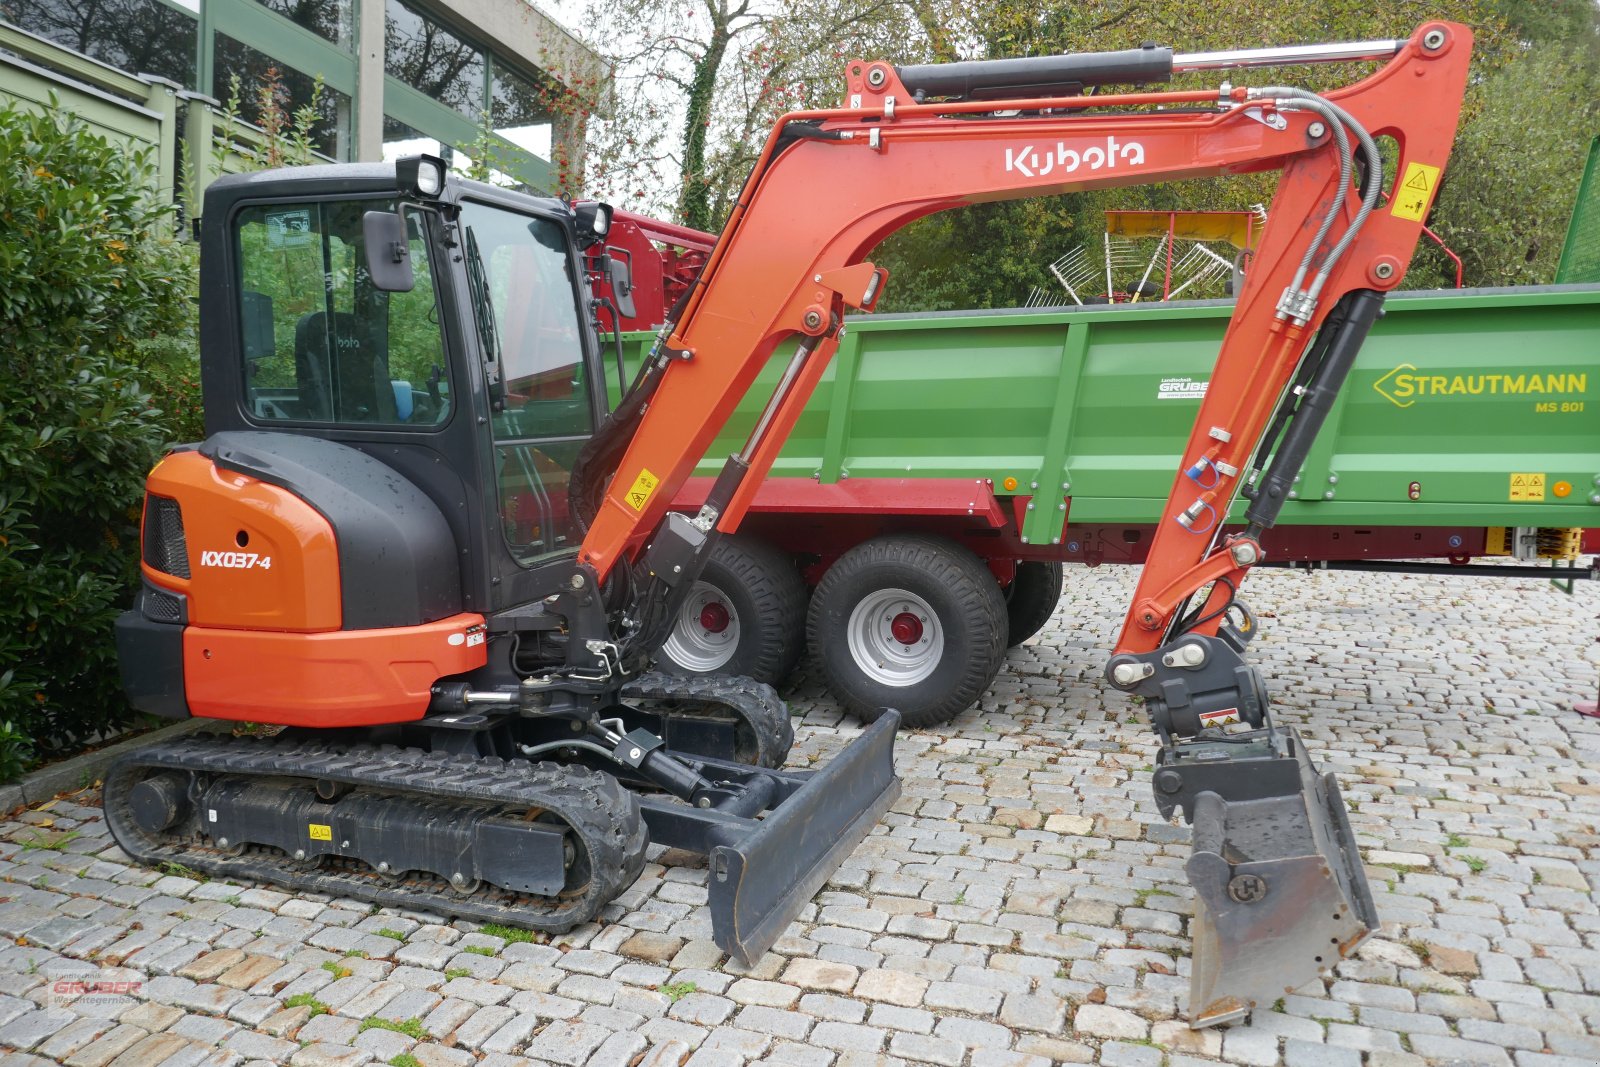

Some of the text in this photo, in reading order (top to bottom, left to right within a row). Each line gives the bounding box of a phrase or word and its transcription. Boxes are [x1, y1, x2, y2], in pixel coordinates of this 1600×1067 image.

[1005, 136, 1145, 177] Kubota
[1159, 382, 1210, 391] GRUBE
[1393, 374, 1587, 397] STRAUTMANN
[1535, 402, 1585, 412] MS 801
[201, 551, 271, 569] KX037-4
